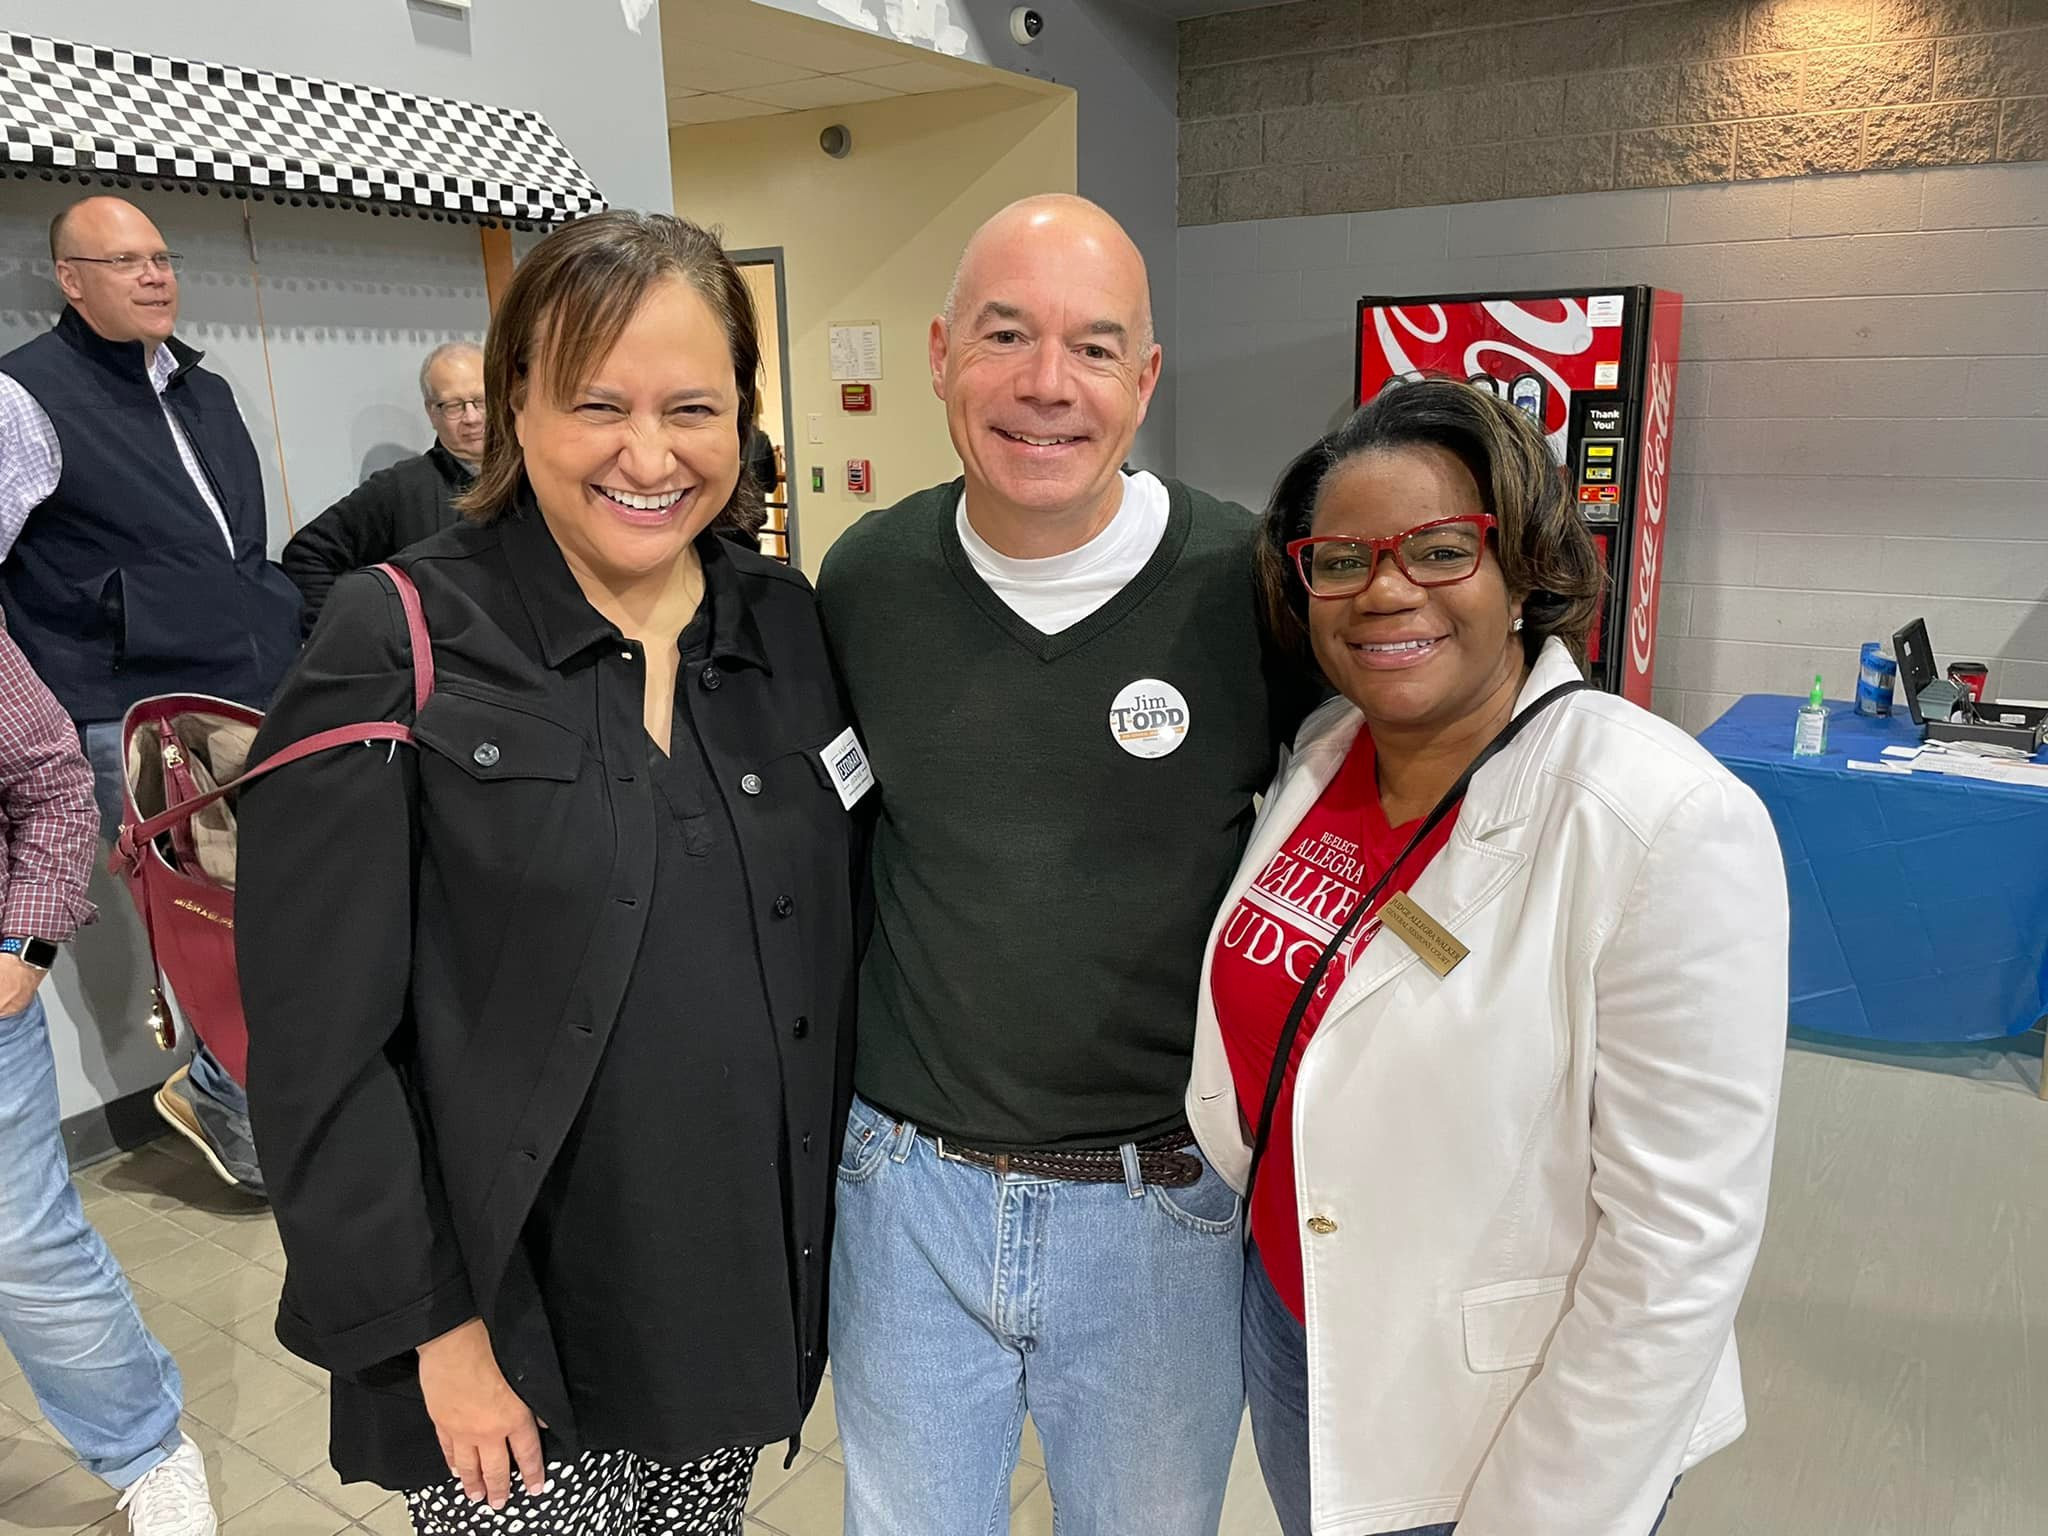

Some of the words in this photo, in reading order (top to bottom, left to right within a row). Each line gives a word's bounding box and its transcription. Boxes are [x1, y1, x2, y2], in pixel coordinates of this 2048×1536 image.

[1590, 409, 1620, 419] Thank
[1593, 420, 1615, 430] You!
[1631, 340, 1672, 675] Coca-Cola
[1110, 708, 1185, 733] TODD
[1131, 694, 1168, 712] Jim
[1292, 838, 1365, 884] ALLEGRA
[1219, 901, 1337, 998] UDG
[1409, 915, 1437, 940] ALLEGRA
[1435, 936, 1462, 961] WALKER
